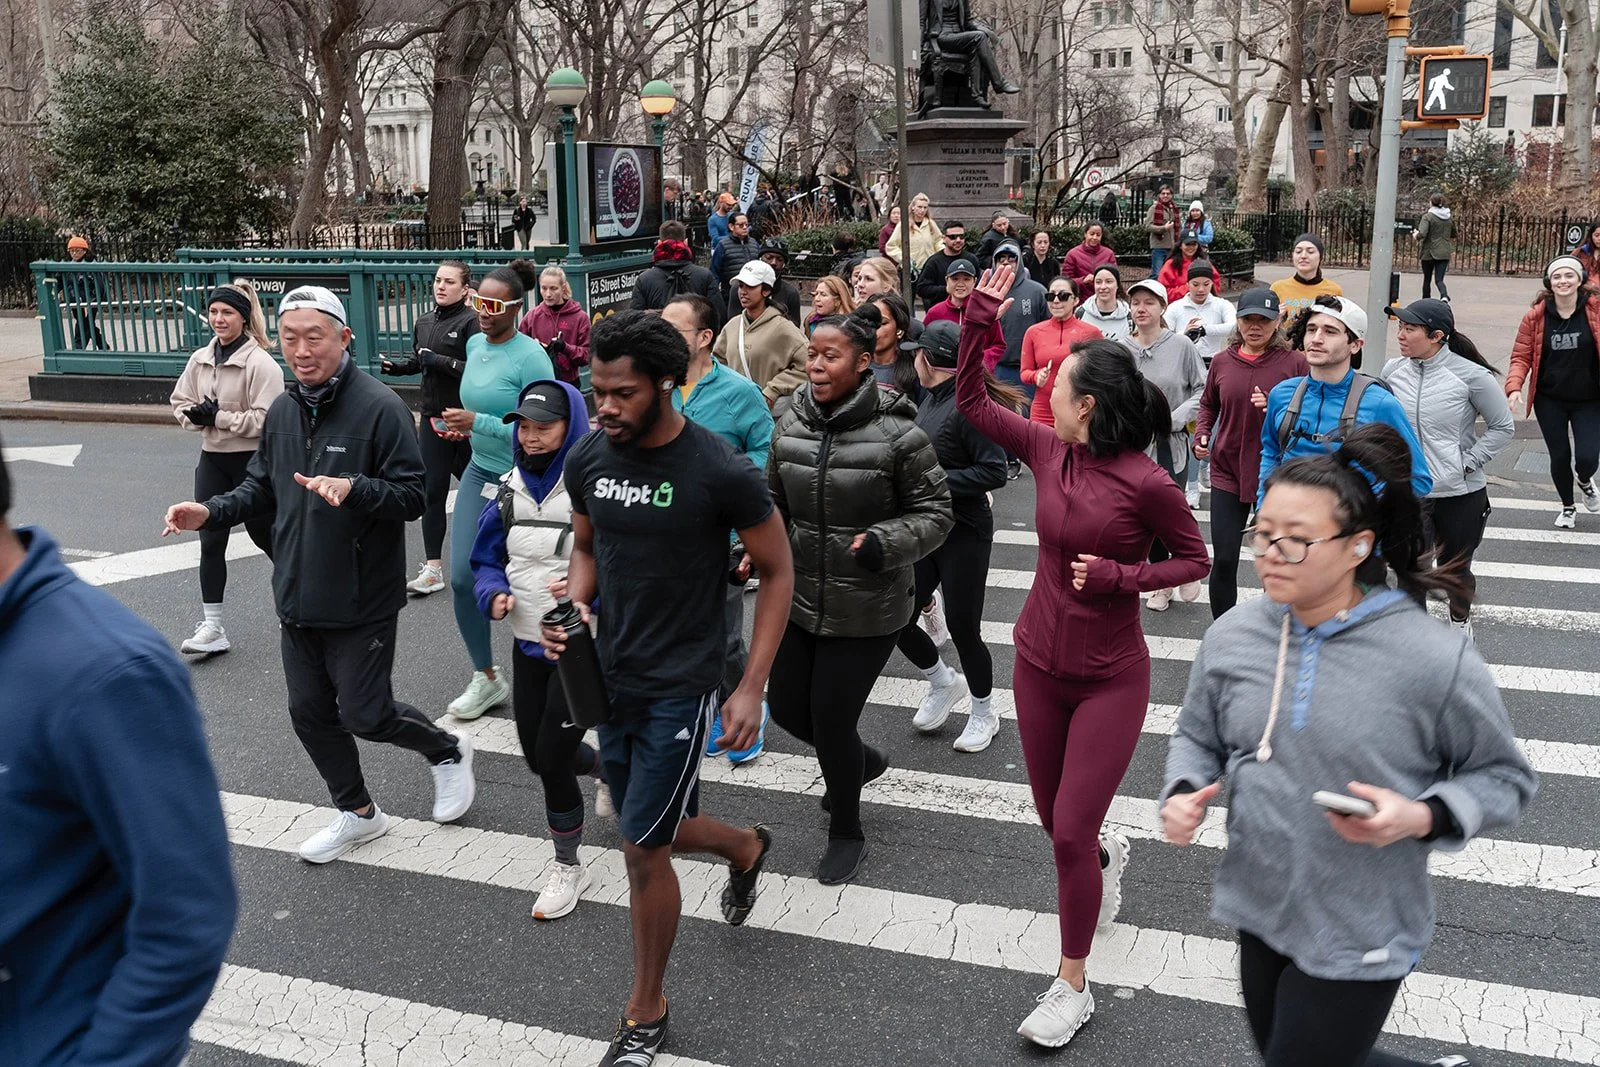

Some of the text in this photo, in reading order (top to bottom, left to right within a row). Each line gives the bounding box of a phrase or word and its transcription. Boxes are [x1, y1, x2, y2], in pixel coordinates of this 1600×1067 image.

[941, 147, 970, 155] WILLIAM
[977, 147, 1004, 155] SEWARD
[740, 144, 759, 203] RUN CUB
[250, 278, 286, 295] bway
[590, 280, 599, 295] 23
[600, 276, 620, 293] Street
[591, 290, 633, 309] Uptown & Queens
[1551, 331, 1580, 350] CAT
[593, 477, 652, 508] Shipt
